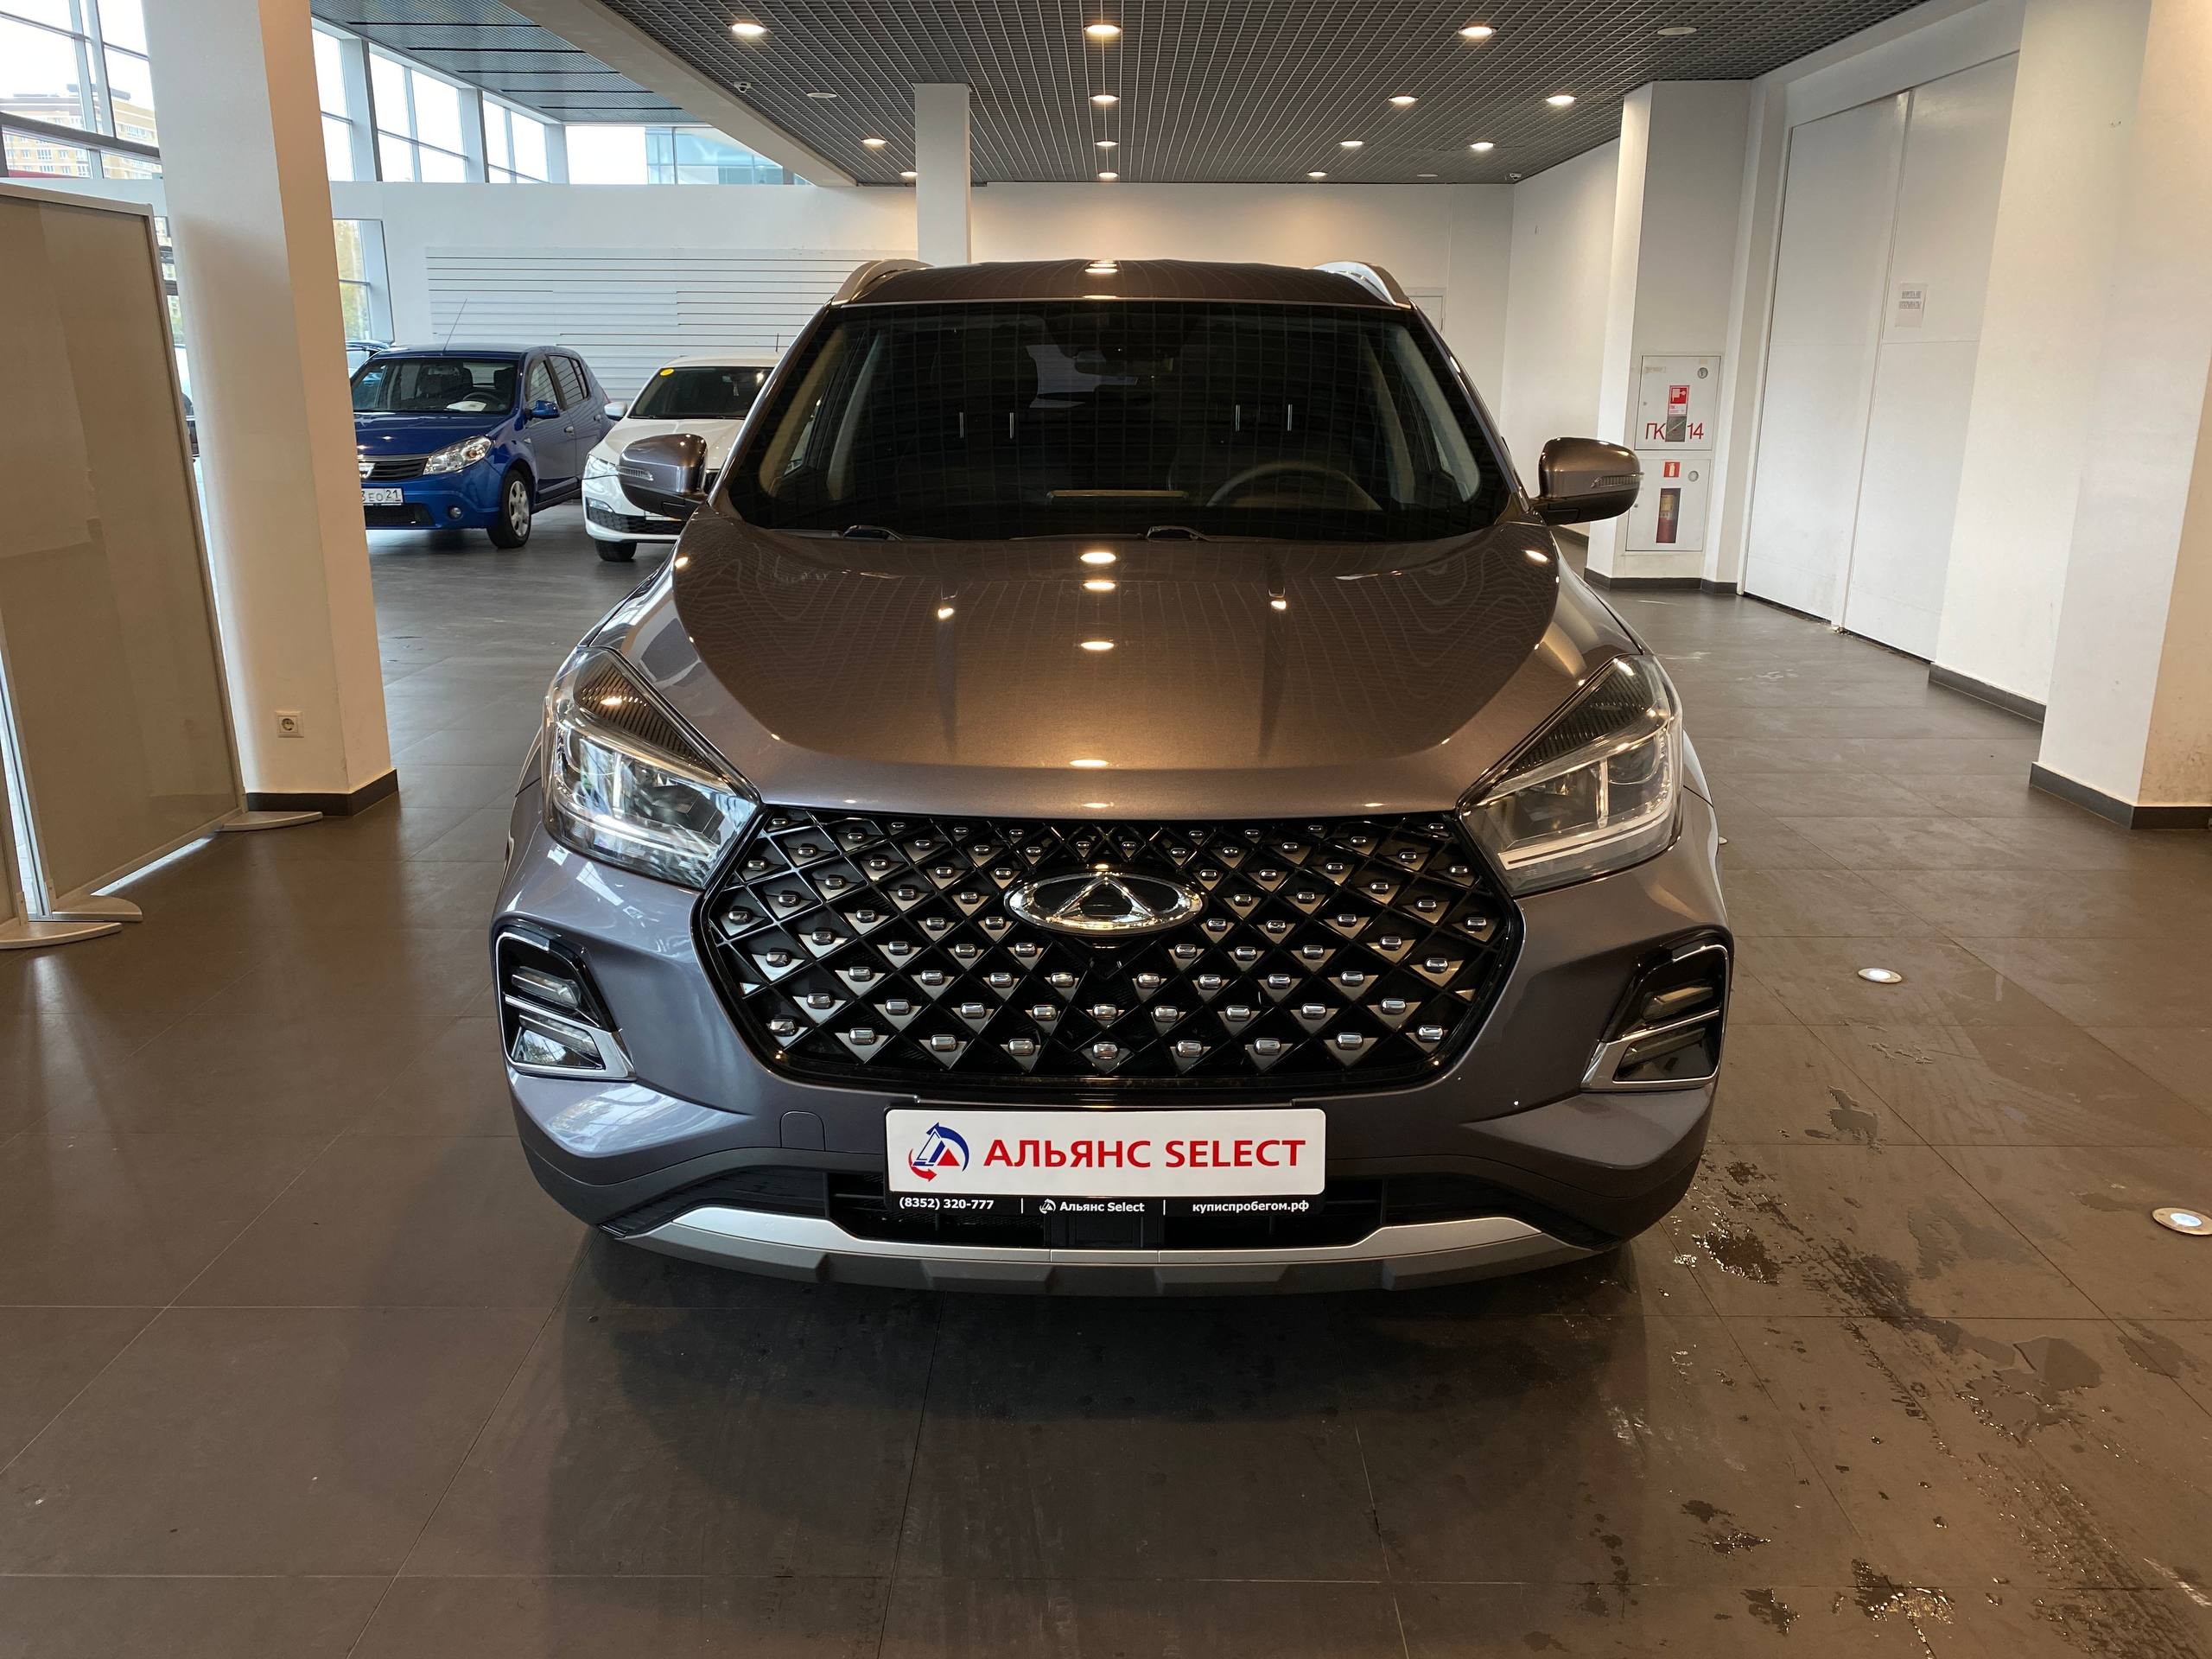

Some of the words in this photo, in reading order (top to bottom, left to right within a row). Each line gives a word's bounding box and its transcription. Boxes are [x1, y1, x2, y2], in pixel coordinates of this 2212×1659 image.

[1645, 423, 1666, 440] ПК
[1688, 423, 1704, 440] 14
[385, 489, 398, 499] 21
[983, 1139, 1150, 1167] АЛЬЯНС
[1166, 1140, 1306, 1166] SELECT
[899, 1197, 940, 1210] (8352)
[943, 1198, 994, 1210] 320-777
[1059, 1202, 1104, 1212] Альянс
[1107, 1202, 1145, 1212] Select
[1192, 1200, 1309, 1214] куписпробегом.рф
